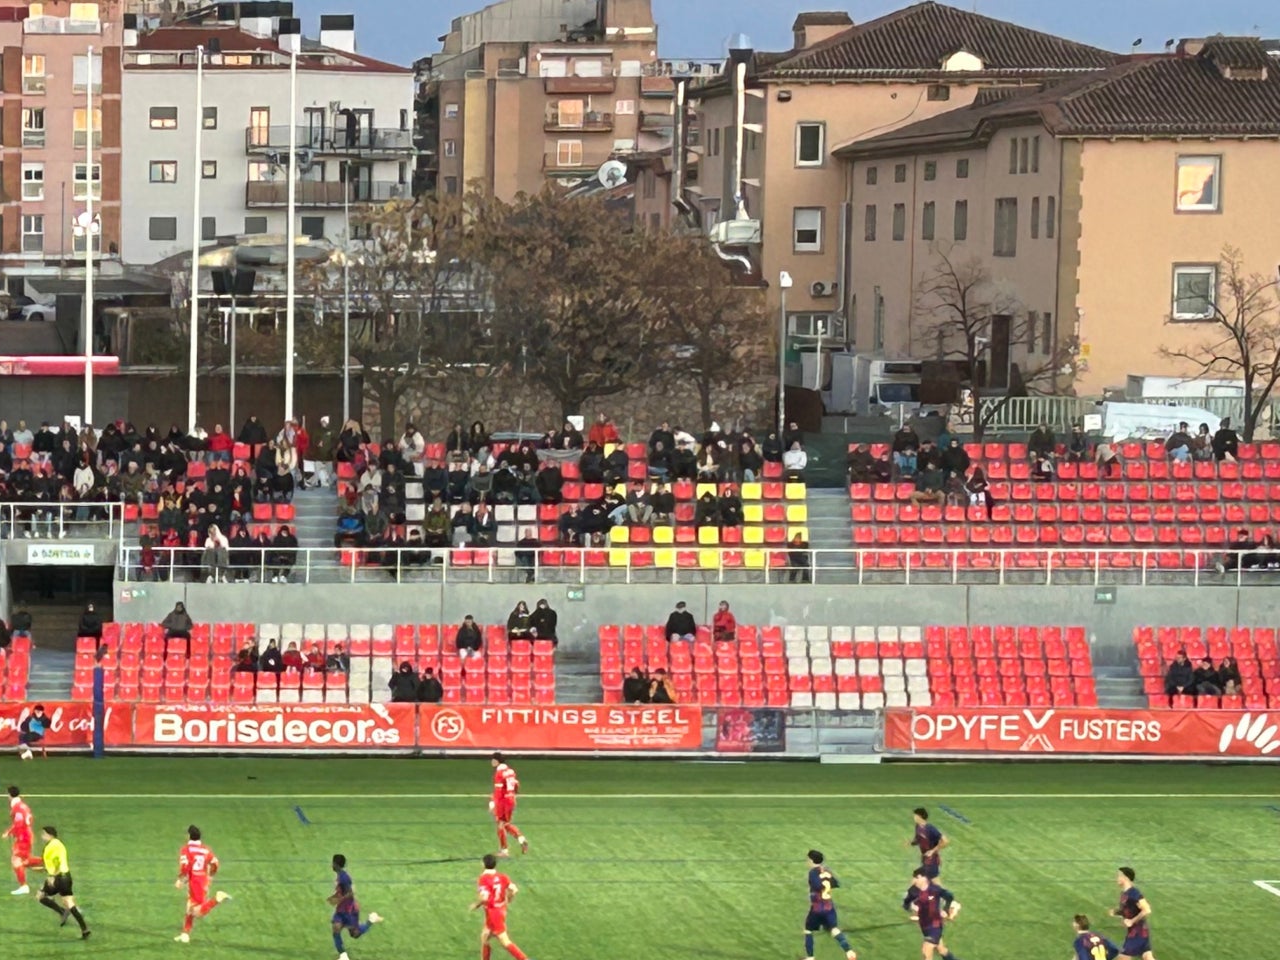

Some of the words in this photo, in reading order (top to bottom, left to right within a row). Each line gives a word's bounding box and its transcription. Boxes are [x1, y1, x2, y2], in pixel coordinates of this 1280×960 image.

[437, 716, 460, 733] FS
[482, 709, 597, 725] FITTINGS
[609, 710, 688, 725] STEEL
[1060, 719, 1161, 742] FUSTERS
